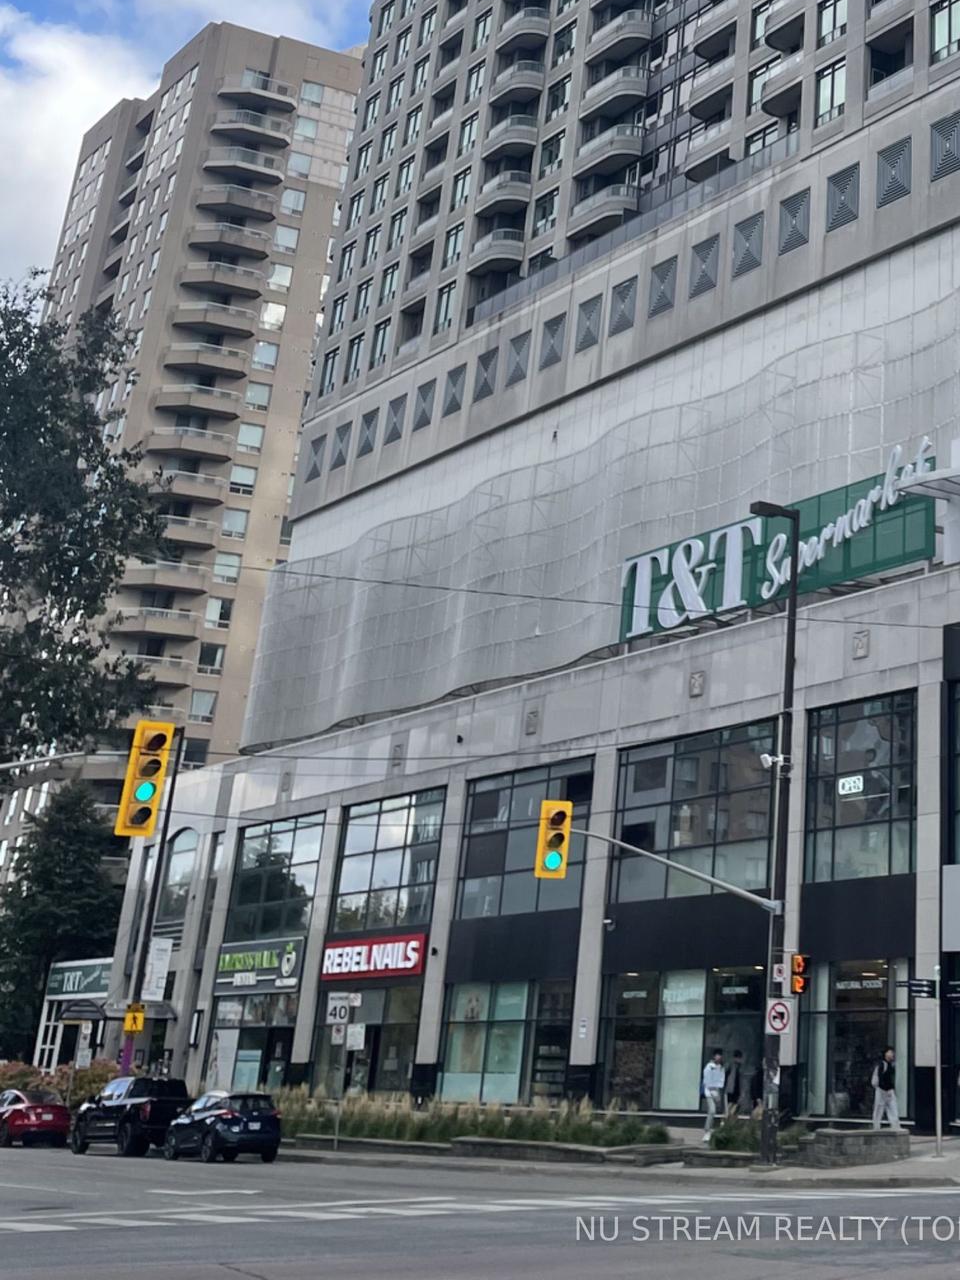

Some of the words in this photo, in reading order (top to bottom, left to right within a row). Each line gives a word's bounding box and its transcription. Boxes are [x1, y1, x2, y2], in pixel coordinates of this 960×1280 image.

[621, 516, 763, 639] T&T
[322, 944, 370, 975] REBEL
[369, 940, 420, 971] NAILS
[328, 1005, 348, 1020] 40
